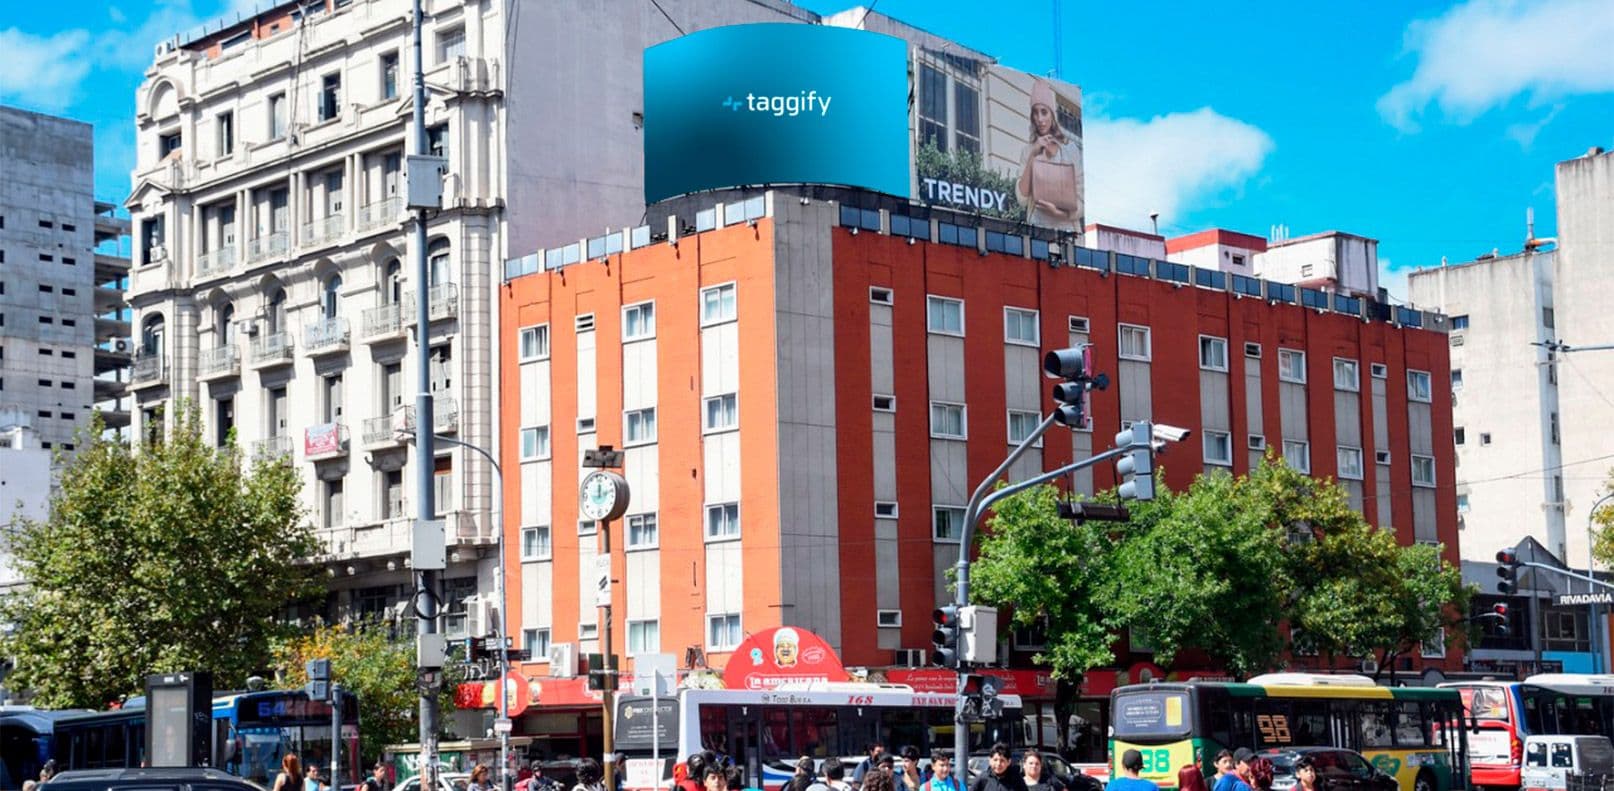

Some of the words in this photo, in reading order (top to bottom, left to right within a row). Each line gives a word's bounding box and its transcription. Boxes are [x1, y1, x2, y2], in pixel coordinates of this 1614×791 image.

[746, 90, 832, 116] taggify
[923, 178, 1007, 212] TRENDY
[1560, 592, 1613, 605] RIVADAVIA
[848, 695, 874, 705] 168
[1256, 714, 1291, 742] 98
